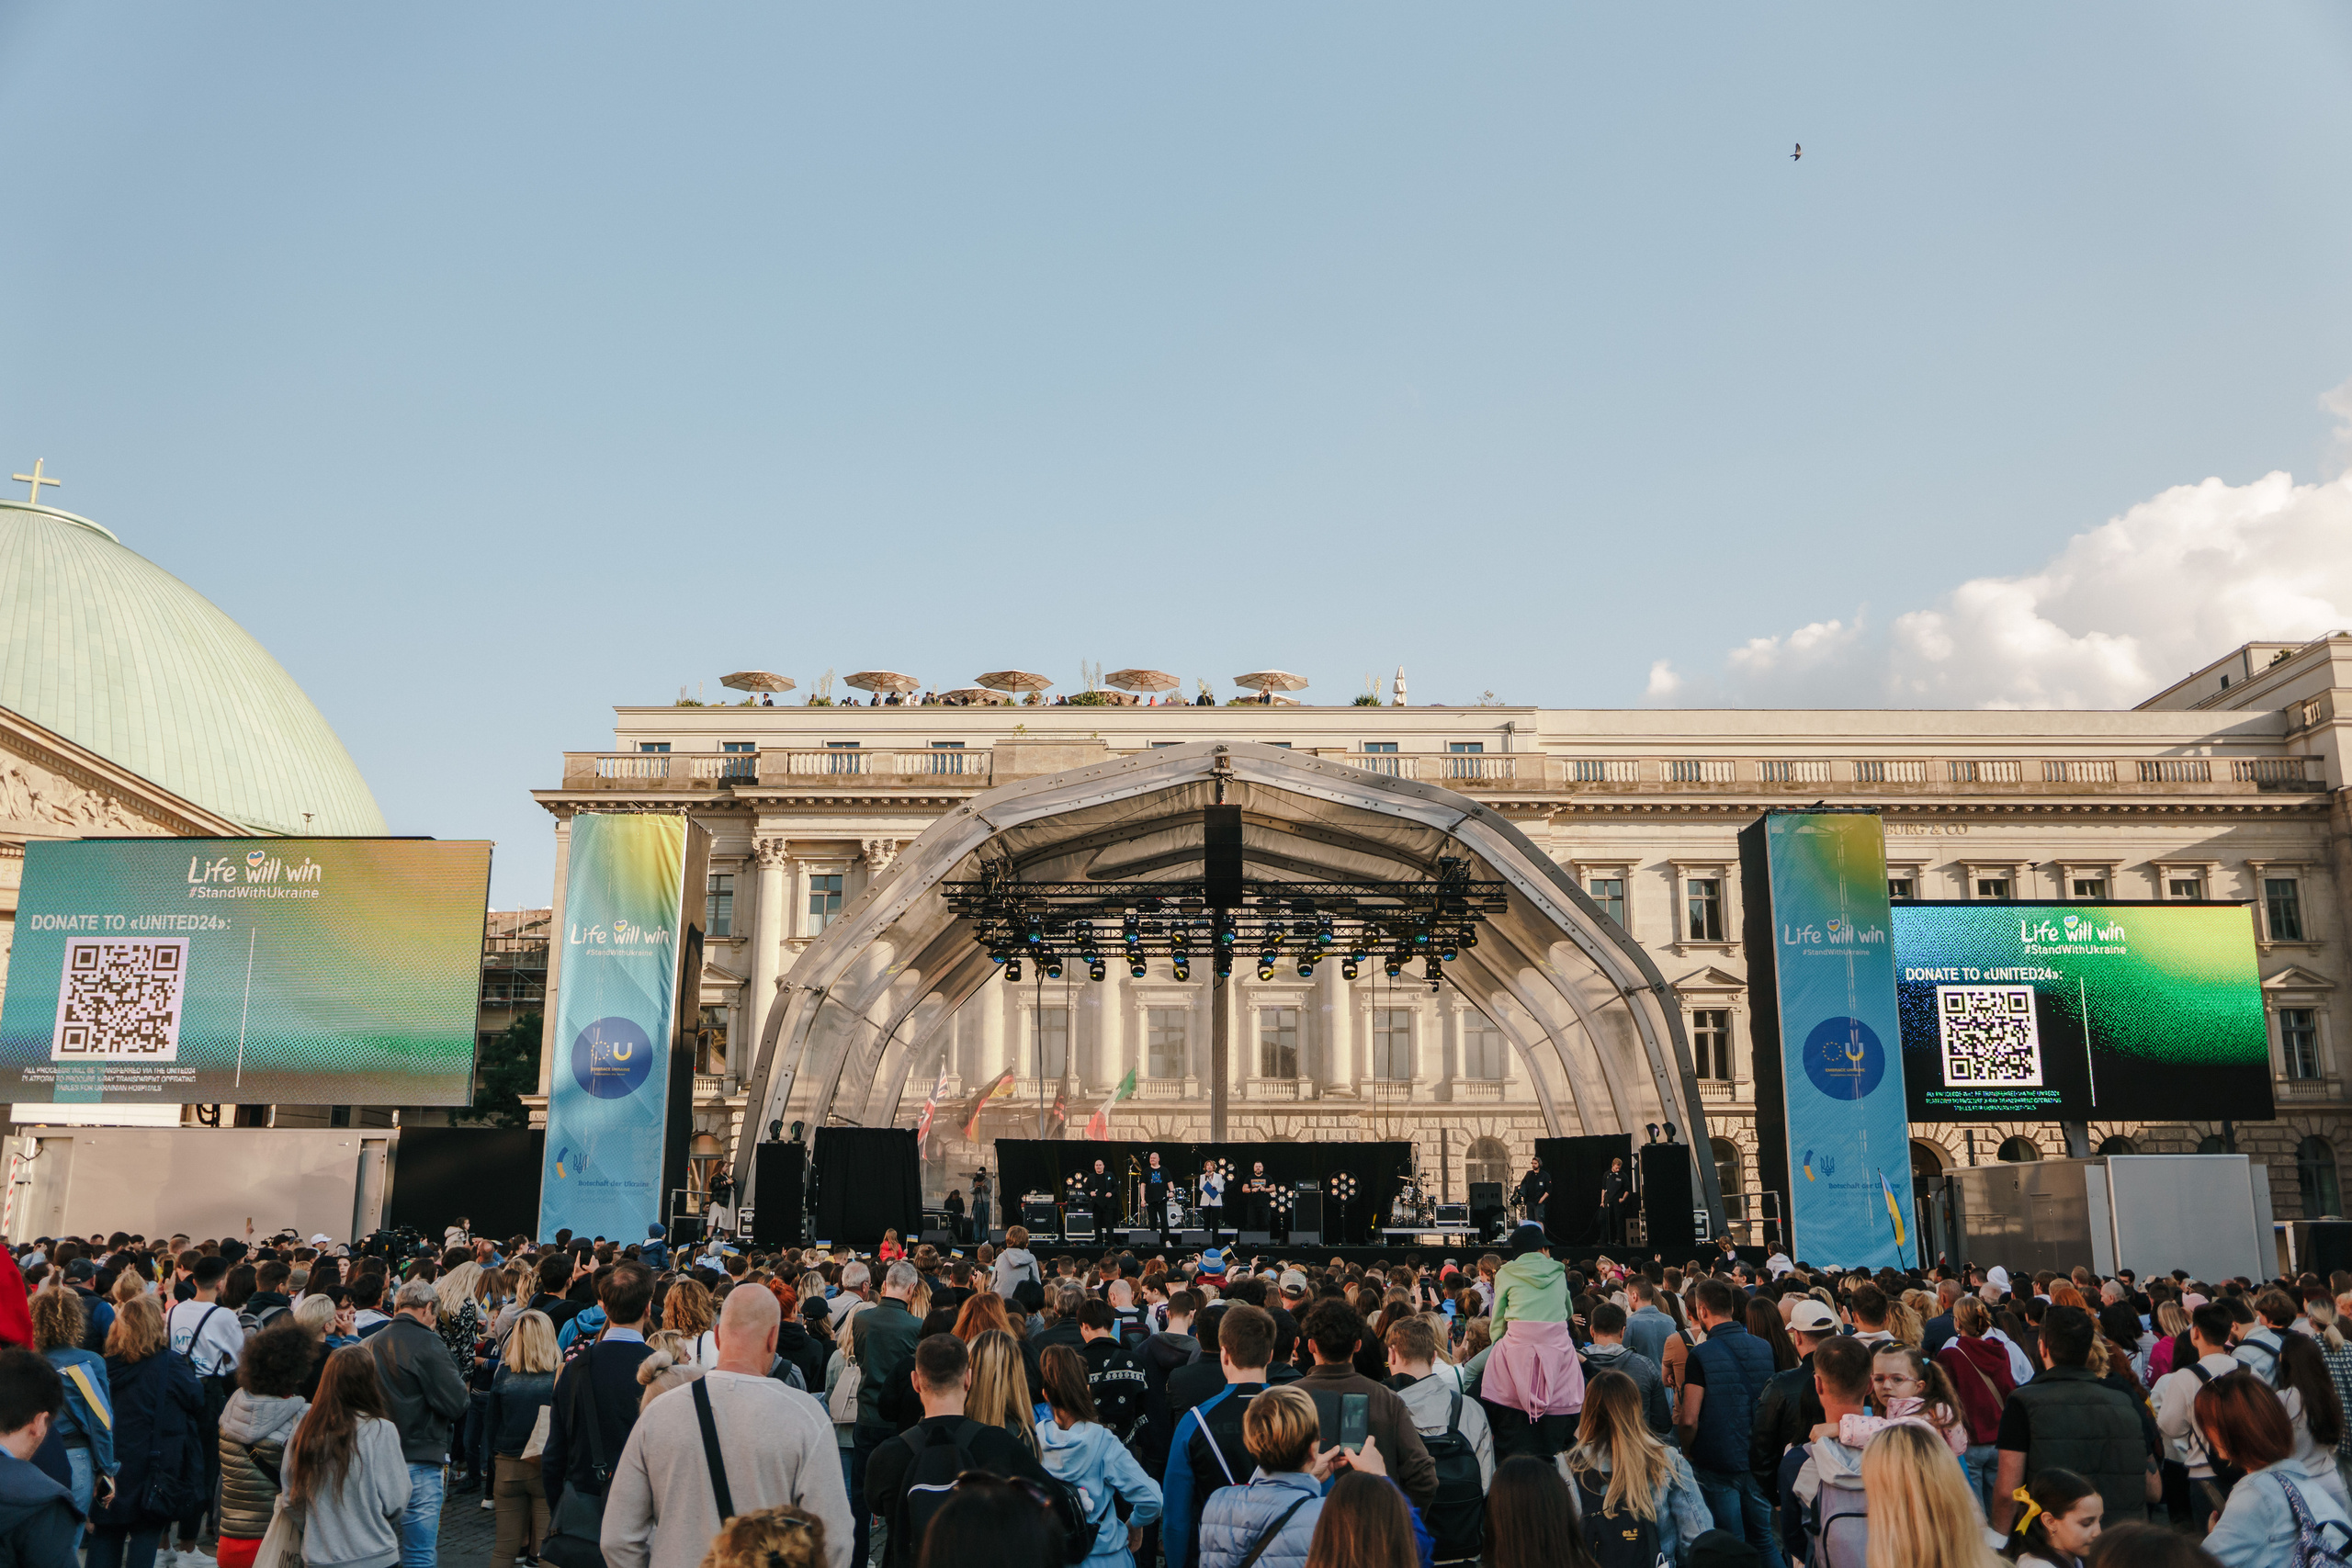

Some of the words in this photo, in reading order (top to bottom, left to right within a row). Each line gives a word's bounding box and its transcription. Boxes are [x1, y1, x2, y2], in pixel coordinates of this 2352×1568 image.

[1929, 824, 1942, 835] &
[1945, 823, 1968, 835] CO
[187, 856, 237, 884] Life
[245, 857, 280, 884] will
[287, 857, 322, 883] win
[188, 886, 319, 899] #StandWithUkraine
[30, 914, 99, 931] DONATE
[103, 914, 127, 931] TO
[570, 922, 607, 945] Life
[613, 925, 640, 945] will
[644, 925, 670, 944] win
[1784, 923, 1822, 945] Life
[1827, 924, 1854, 944] will
[1857, 924, 1885, 944] win
[2021, 919, 2059, 942] Life
[2064, 920, 2092, 942] will
[2096, 920, 2126, 942] win
[586, 948, 653, 956] #StandWithUkraine
[1802, 948, 1870, 956] #StandWithUkraine
[2024, 944, 2127, 955] #StandWithUkraine
[1905, 967, 1959, 981] DONATE
[1962, 967, 1980, 981] TO
